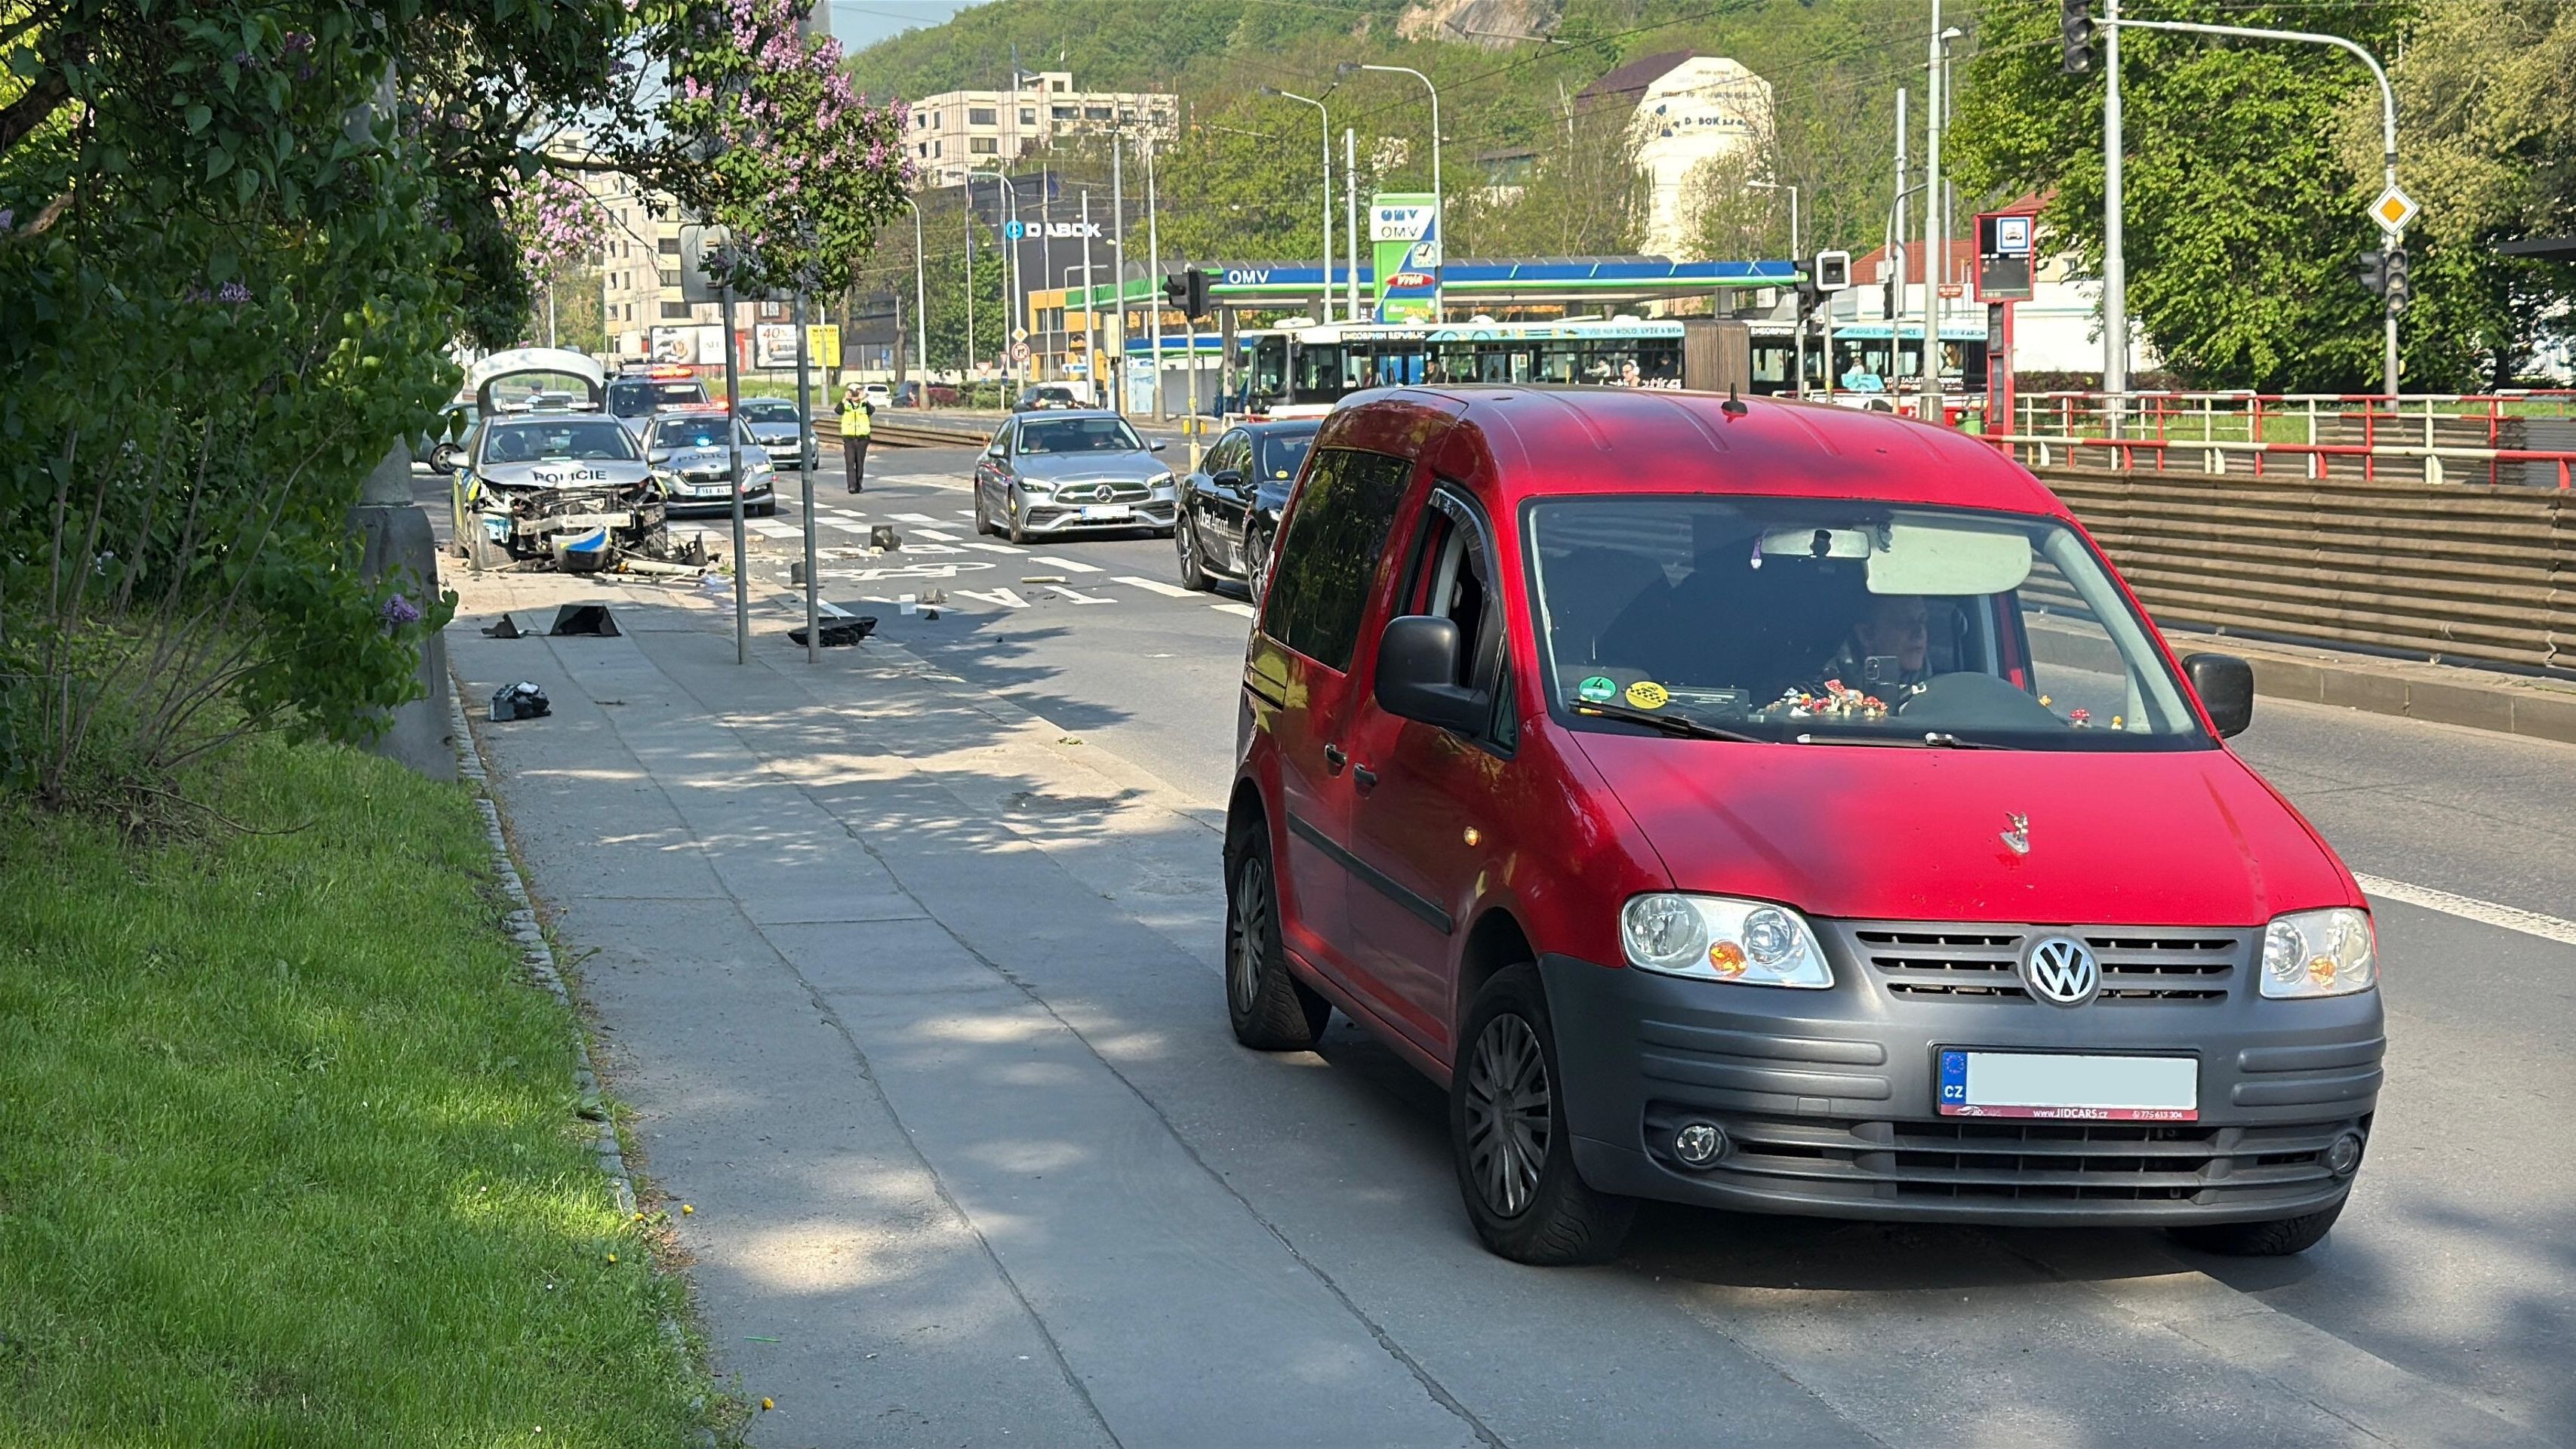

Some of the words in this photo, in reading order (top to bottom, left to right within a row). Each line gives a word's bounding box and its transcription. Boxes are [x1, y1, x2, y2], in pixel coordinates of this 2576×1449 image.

[1685, 117, 1720, 125] DBOK
[1380, 209, 1419, 221] OMV
[1380, 226, 1418, 238] OMV
[1228, 269, 1269, 285] OMV
[678, 453, 728, 463] POLIC
[532, 470, 607, 482] POLICIE
[1199, 506, 1211, 530] Uber
[1593, 678, 1603, 689] 4
[1944, 1084, 1963, 1098] CZ
